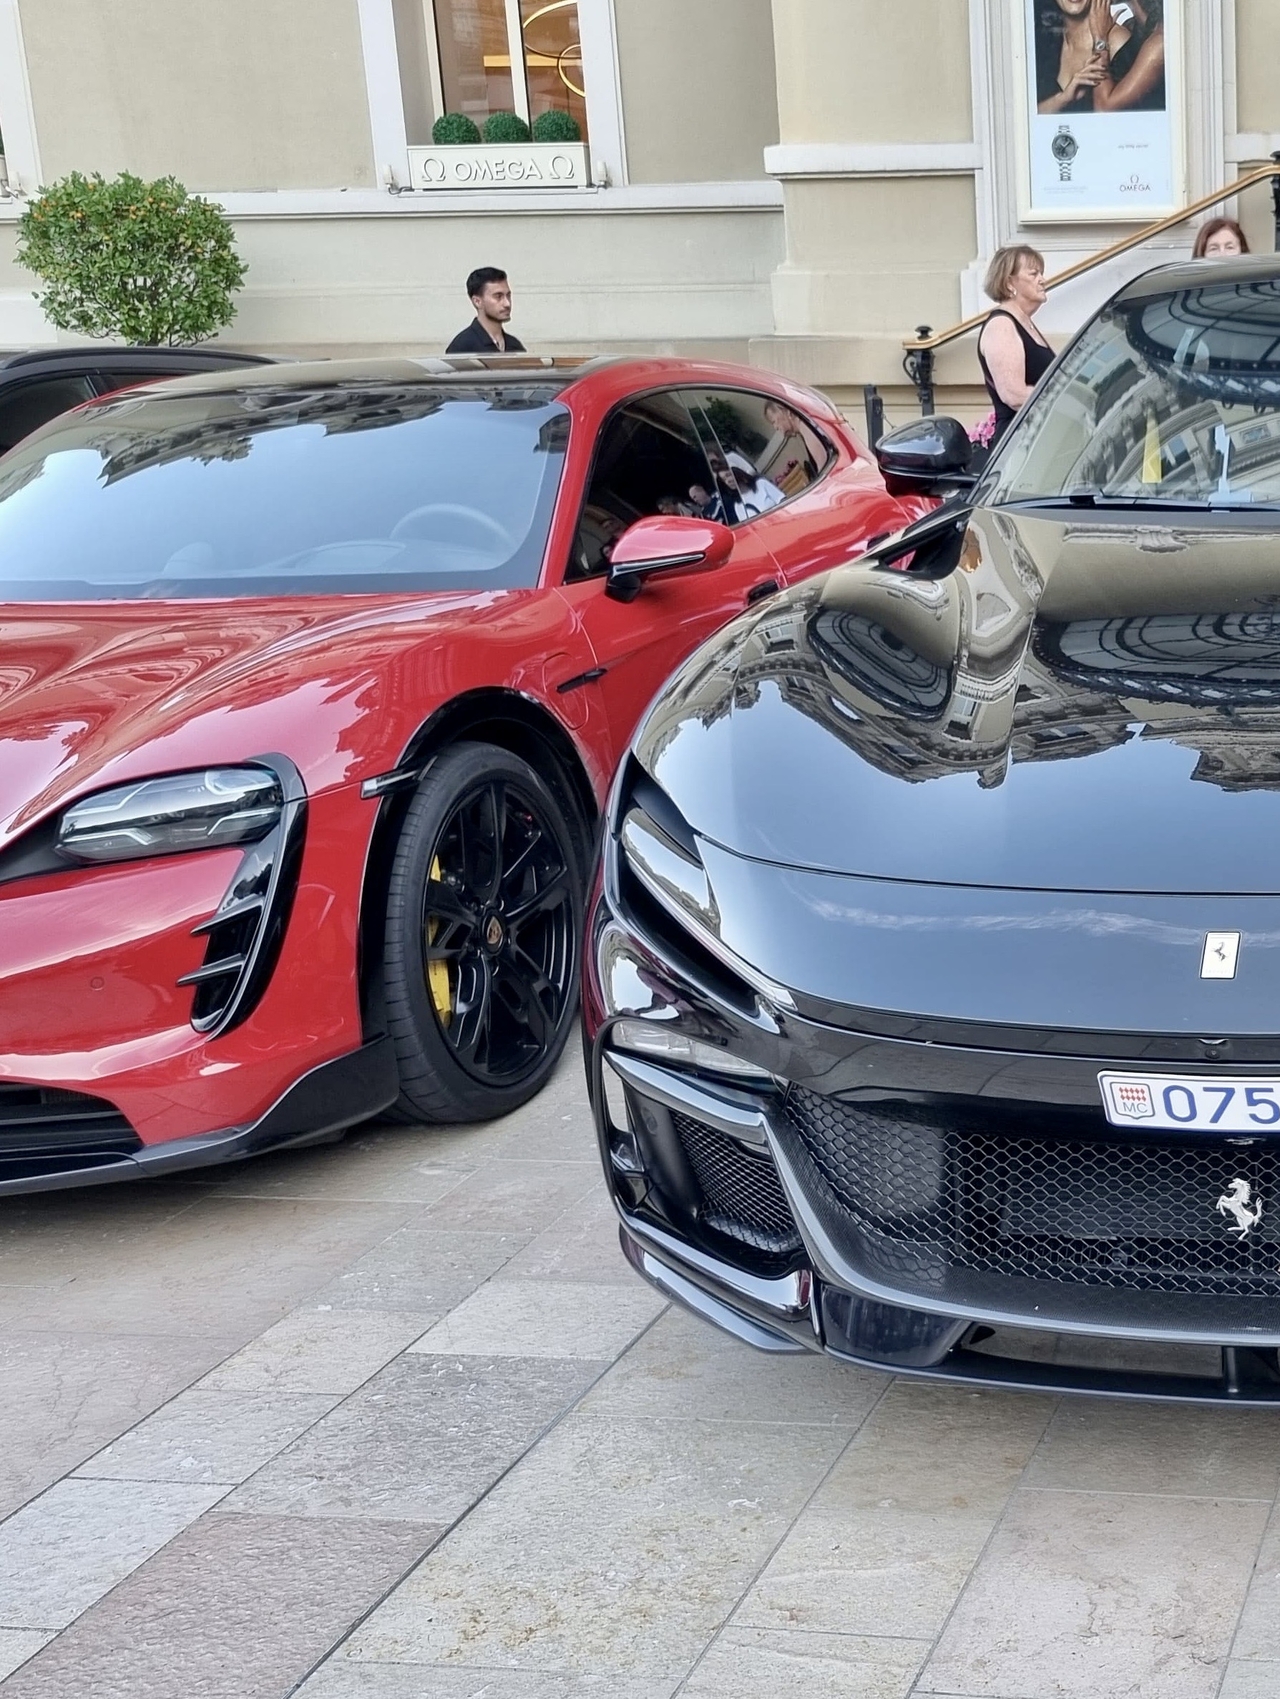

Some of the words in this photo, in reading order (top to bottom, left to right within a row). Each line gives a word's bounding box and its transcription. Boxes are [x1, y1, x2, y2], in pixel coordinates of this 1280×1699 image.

[455, 158, 543, 182] OMEGA
[1119, 183, 1152, 192] OMEGA
[1122, 1101, 1149, 1114] MC
